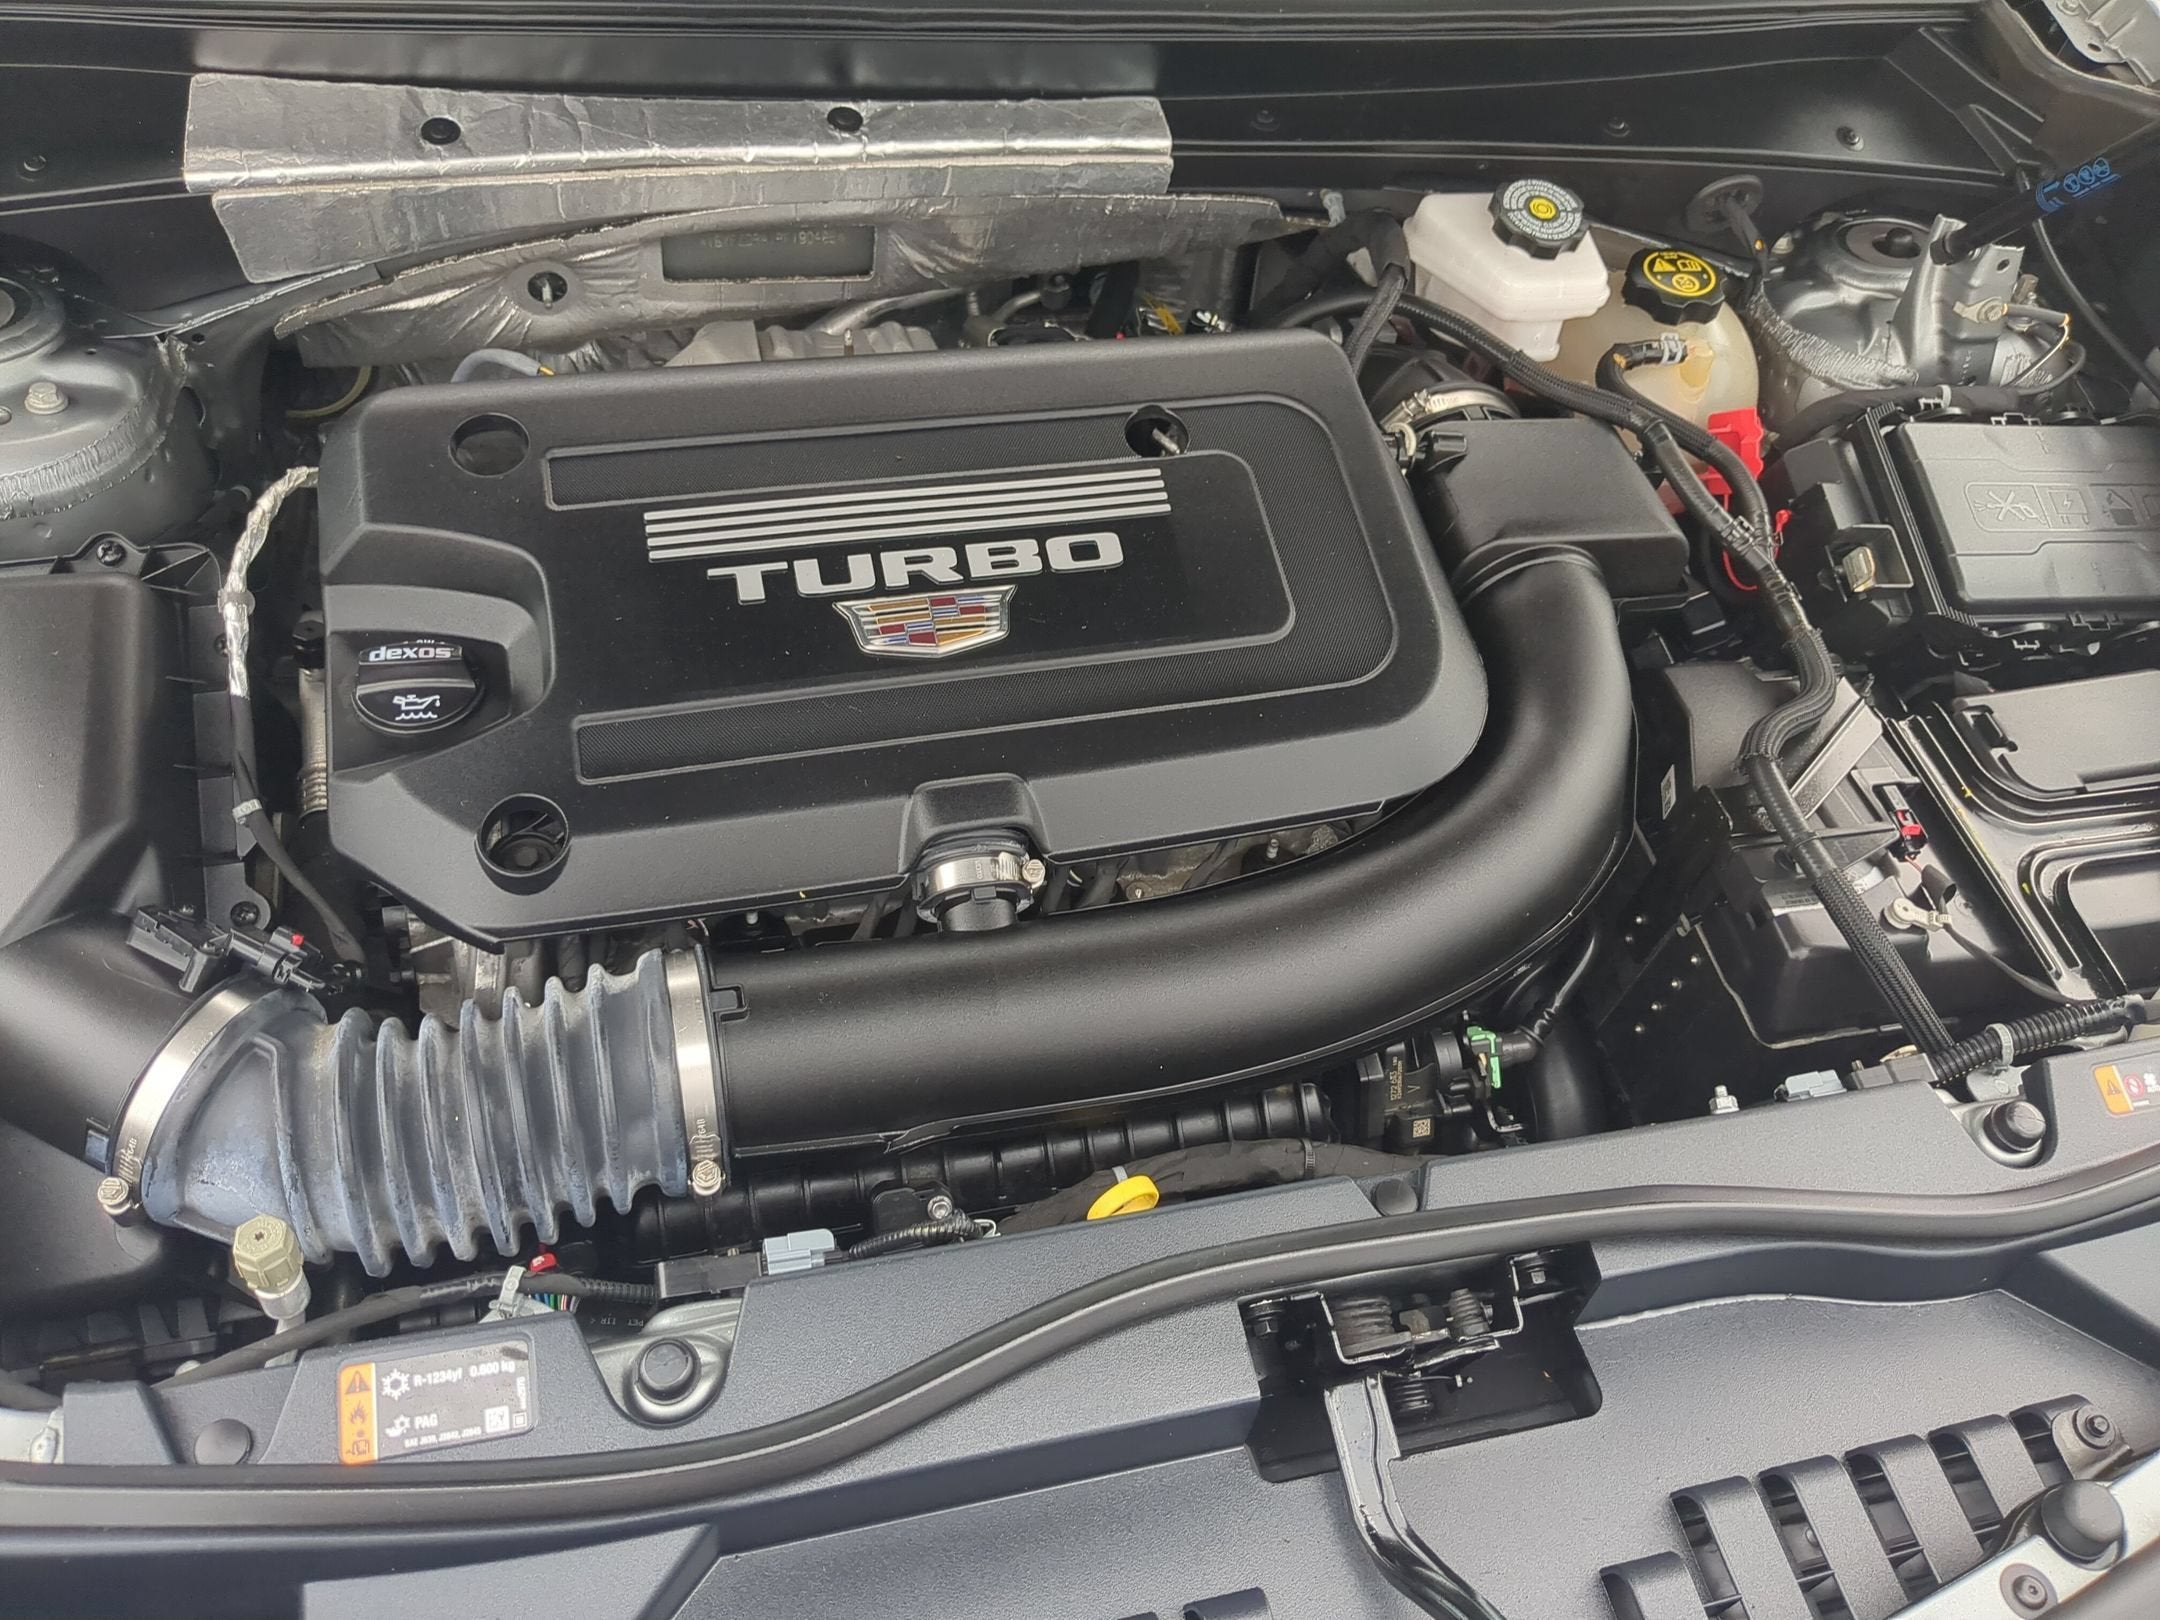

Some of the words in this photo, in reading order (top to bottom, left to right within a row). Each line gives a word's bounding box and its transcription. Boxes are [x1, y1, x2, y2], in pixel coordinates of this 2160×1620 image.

[707, 532, 1124, 605] TURBO
[369, 646, 454, 661] dexos
[413, 1367, 463, 1386] R-1234yf
[501, 1360, 516, 1374] kg
[414, 1413, 438, 1429] PAG
